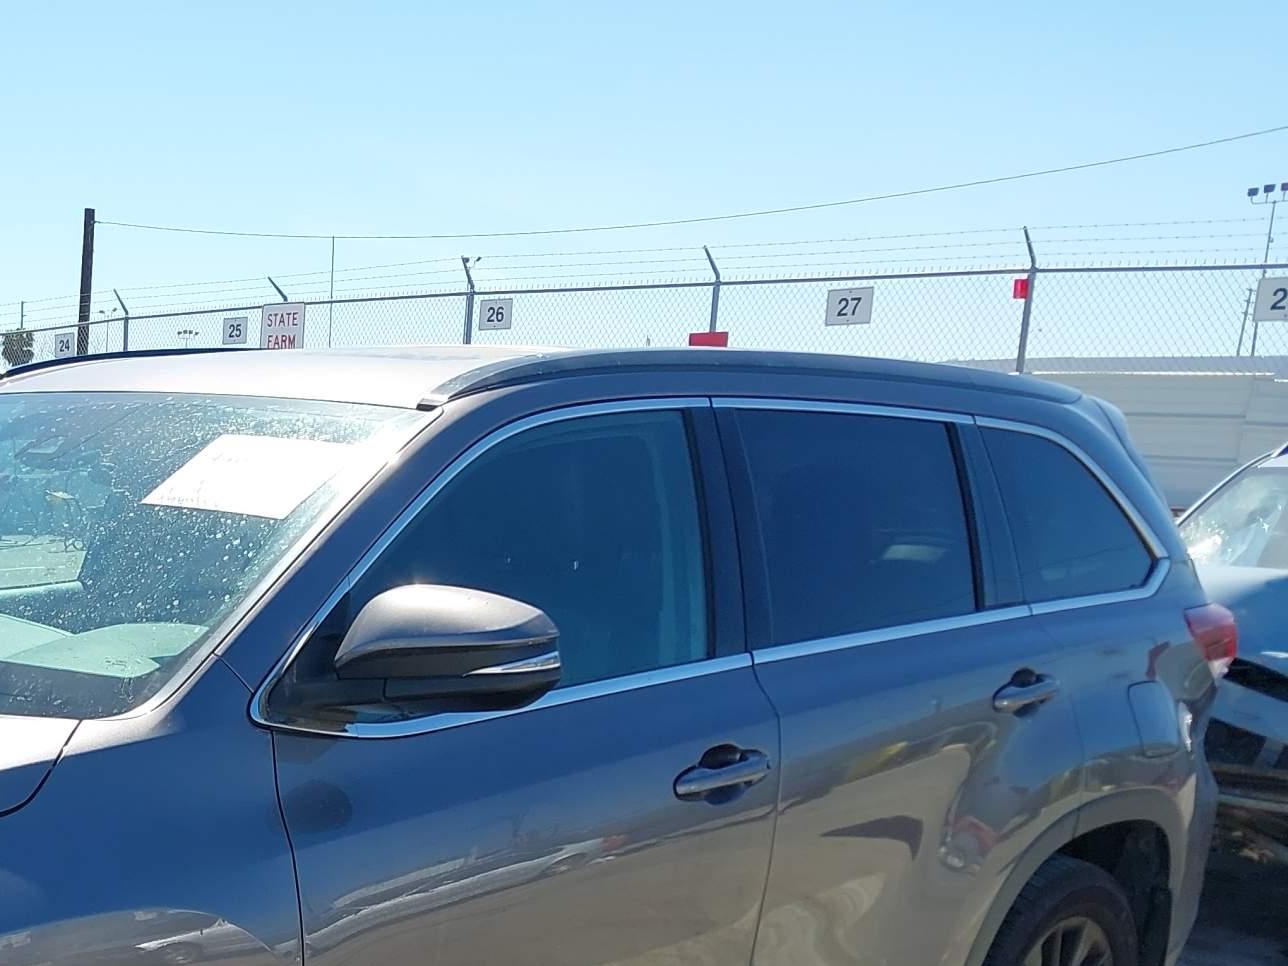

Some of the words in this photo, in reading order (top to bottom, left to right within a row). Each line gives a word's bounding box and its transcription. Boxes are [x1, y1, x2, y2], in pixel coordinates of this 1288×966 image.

[487, 306, 504, 323] 26
[836, 297, 862, 317] 27
[267, 312, 299, 327] STATE
[228, 323, 242, 338] 25
[59, 338, 70, 353] 24
[267, 334, 296, 350] FARM
